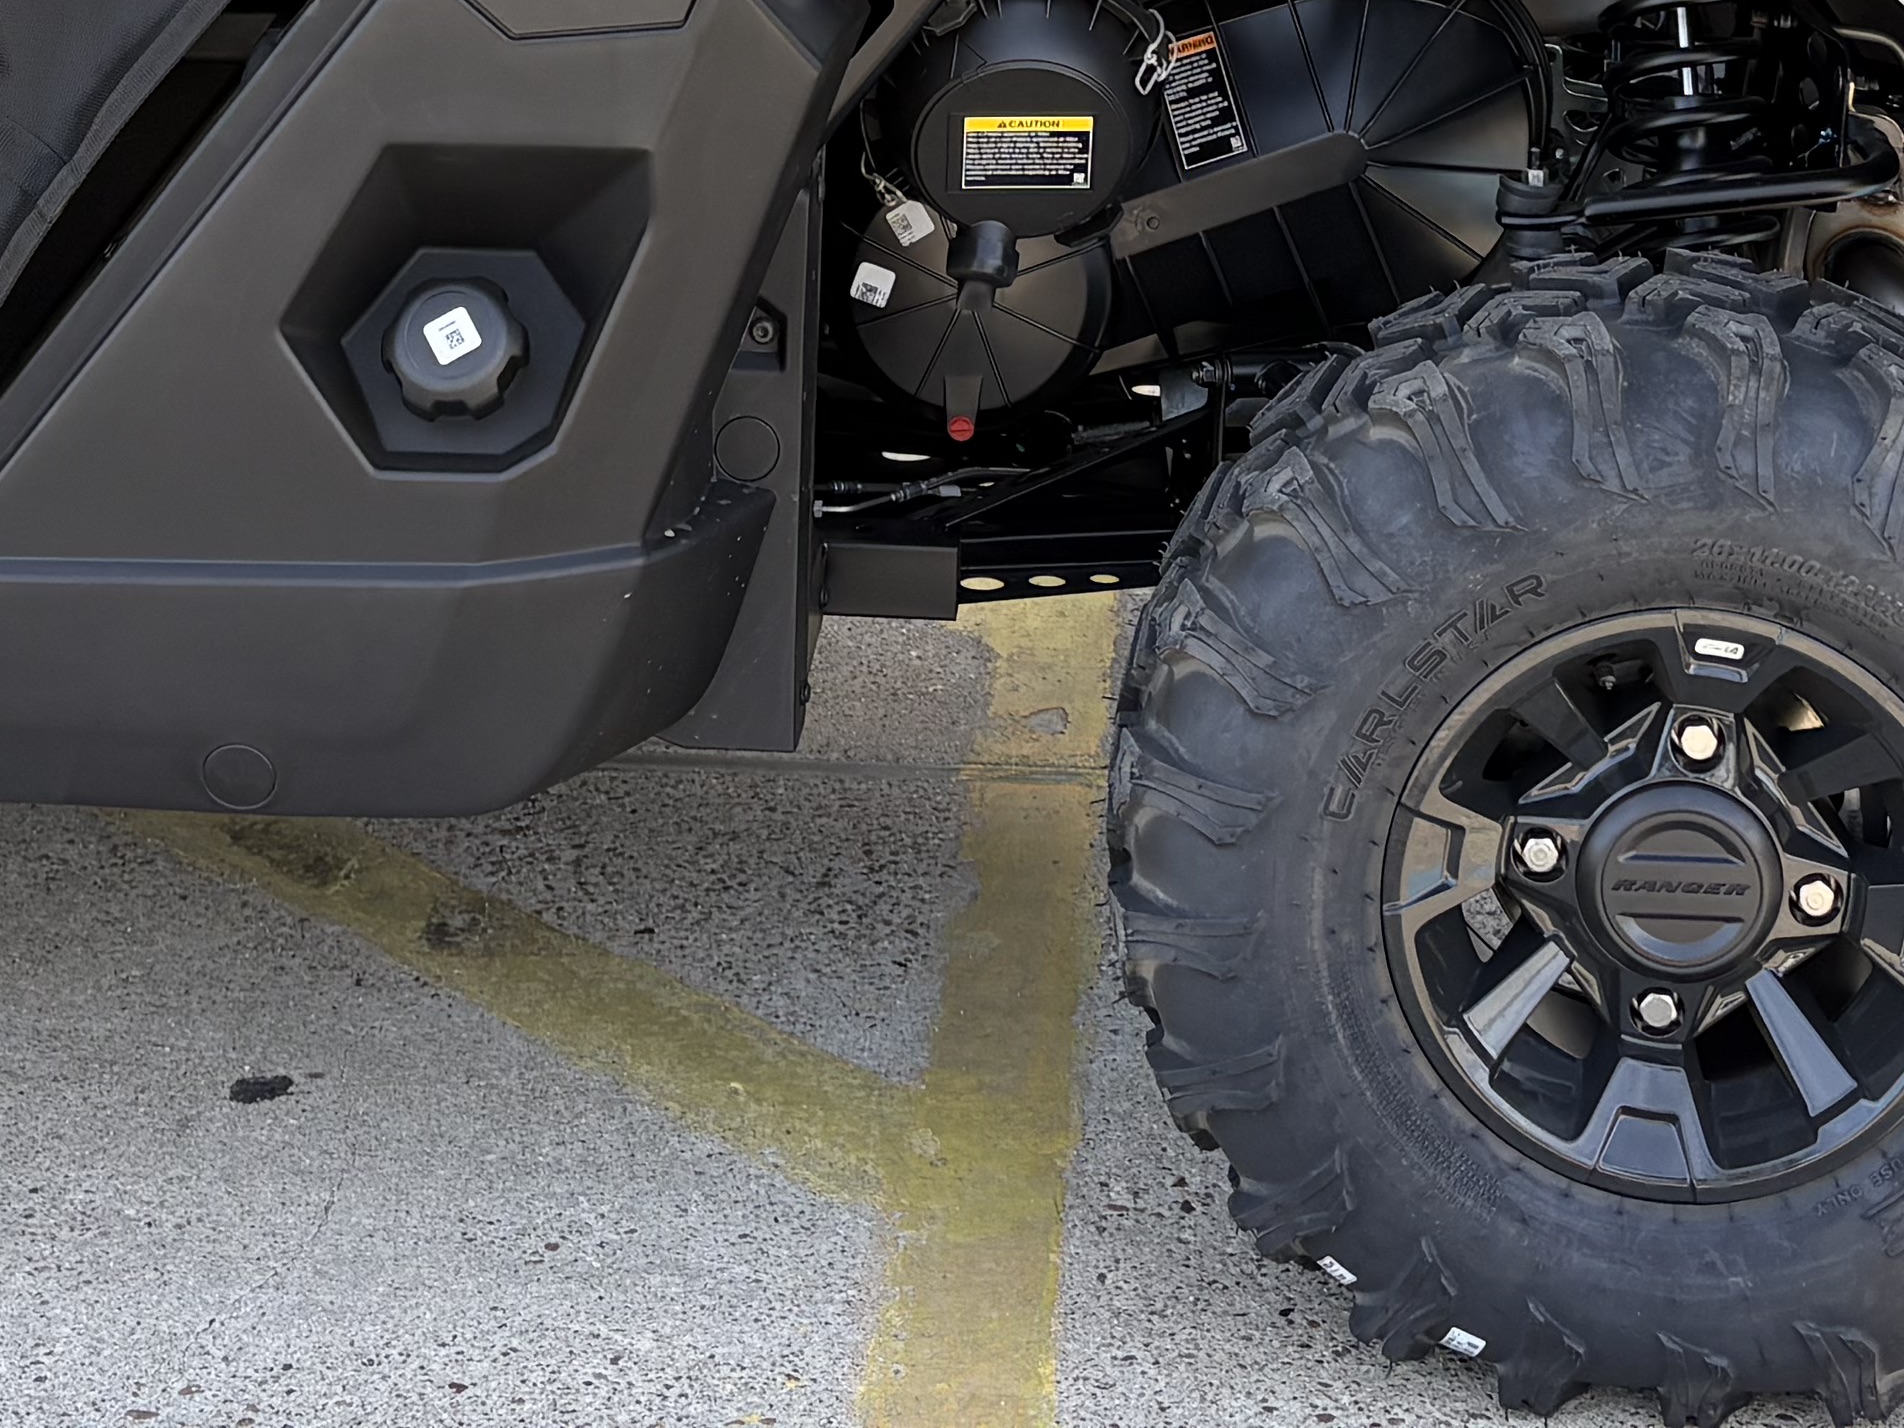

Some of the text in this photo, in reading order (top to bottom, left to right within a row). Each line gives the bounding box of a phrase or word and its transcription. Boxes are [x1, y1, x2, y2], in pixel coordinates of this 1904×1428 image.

[1008, 119, 1061, 129] CAUTION
[1320, 572, 1547, 822] CARLSTAR
[1610, 877, 1752, 897] RANGER
[1868, 1157, 1904, 1188] USE
[1814, 1182, 1866, 1218] ONLY
